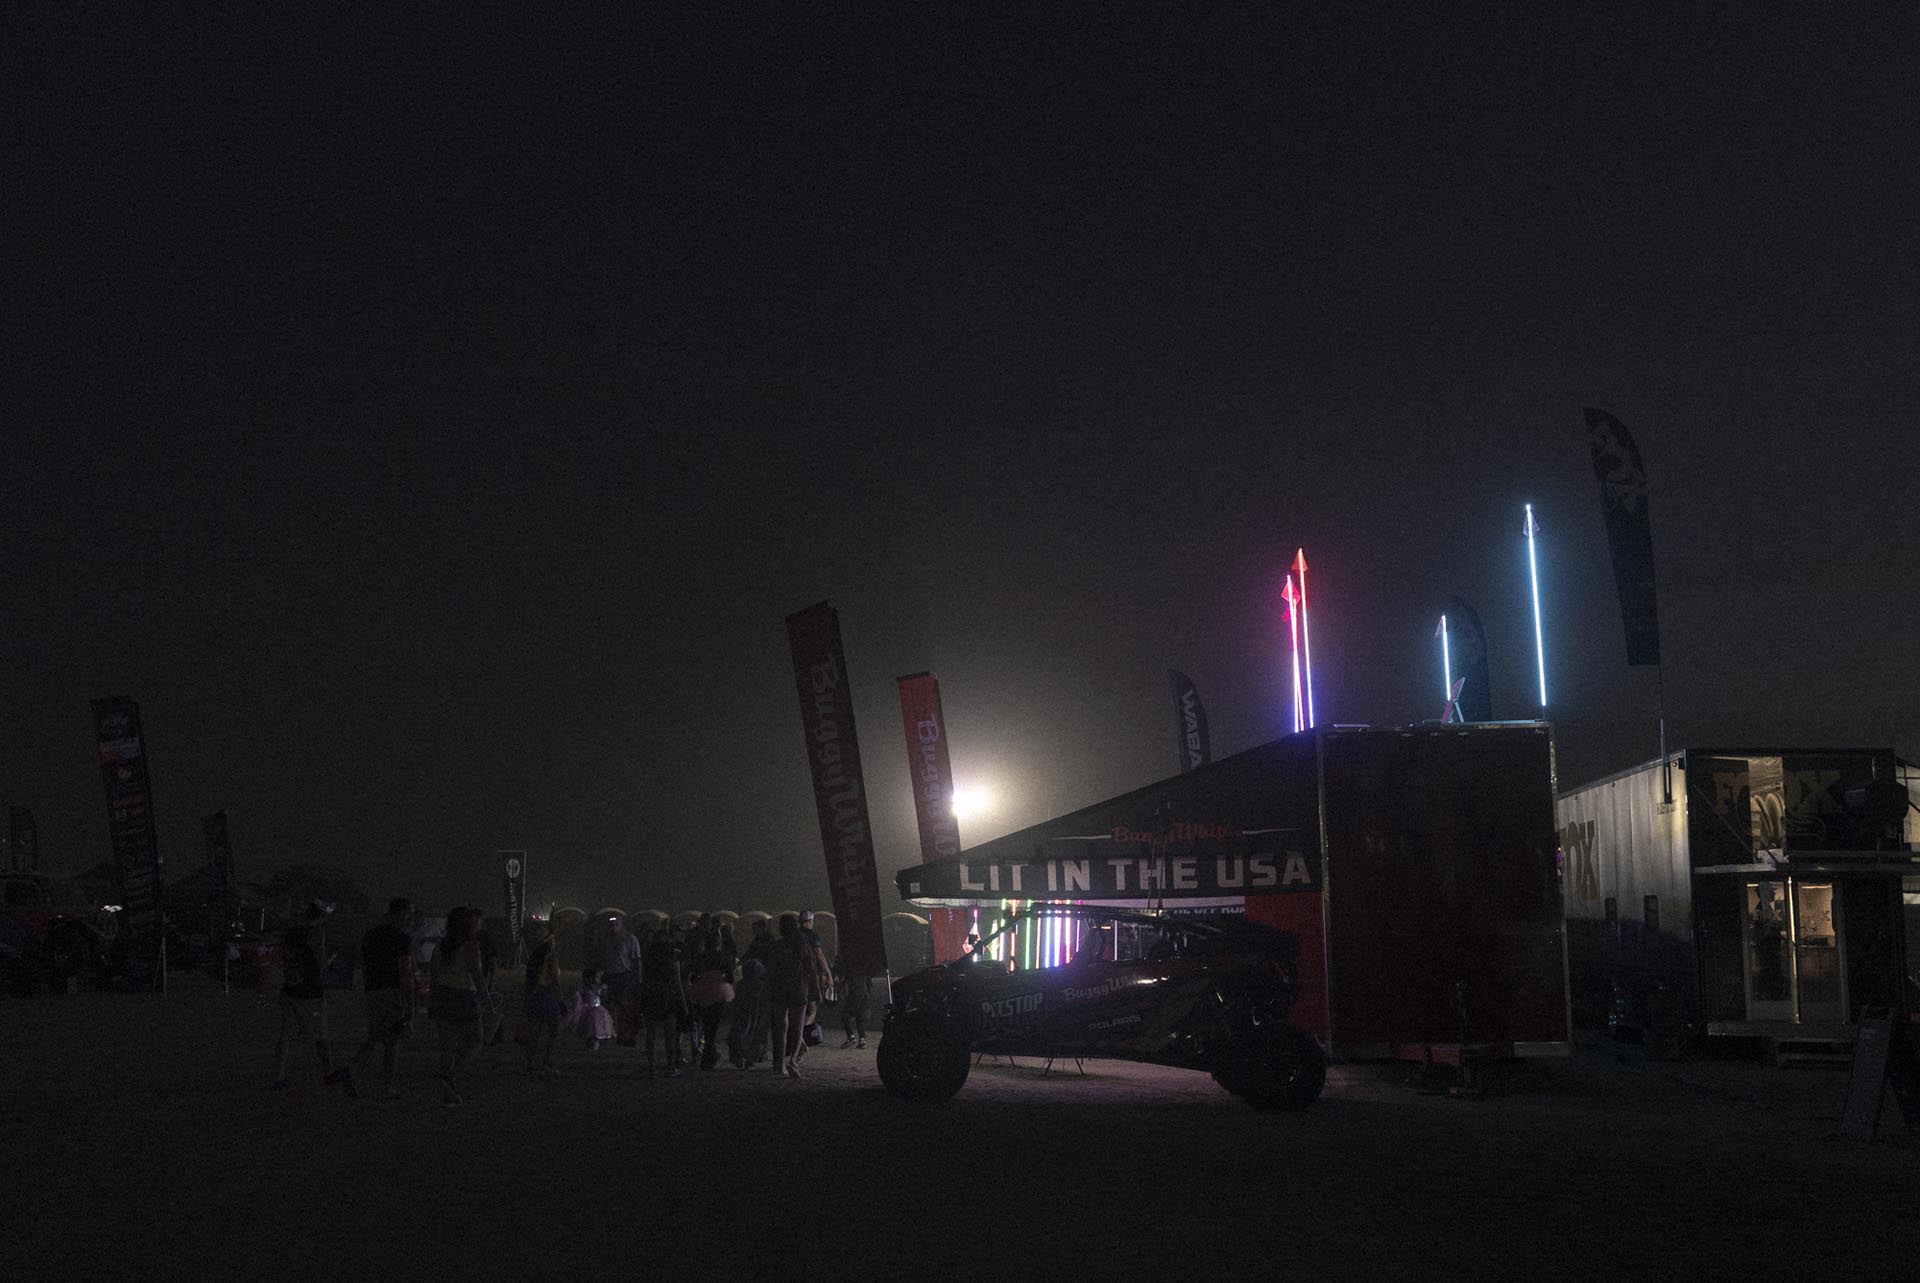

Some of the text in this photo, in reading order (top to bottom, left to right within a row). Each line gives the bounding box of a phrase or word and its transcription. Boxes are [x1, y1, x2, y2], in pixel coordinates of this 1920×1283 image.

[959, 850, 1312, 892] LIT IN THE USA
